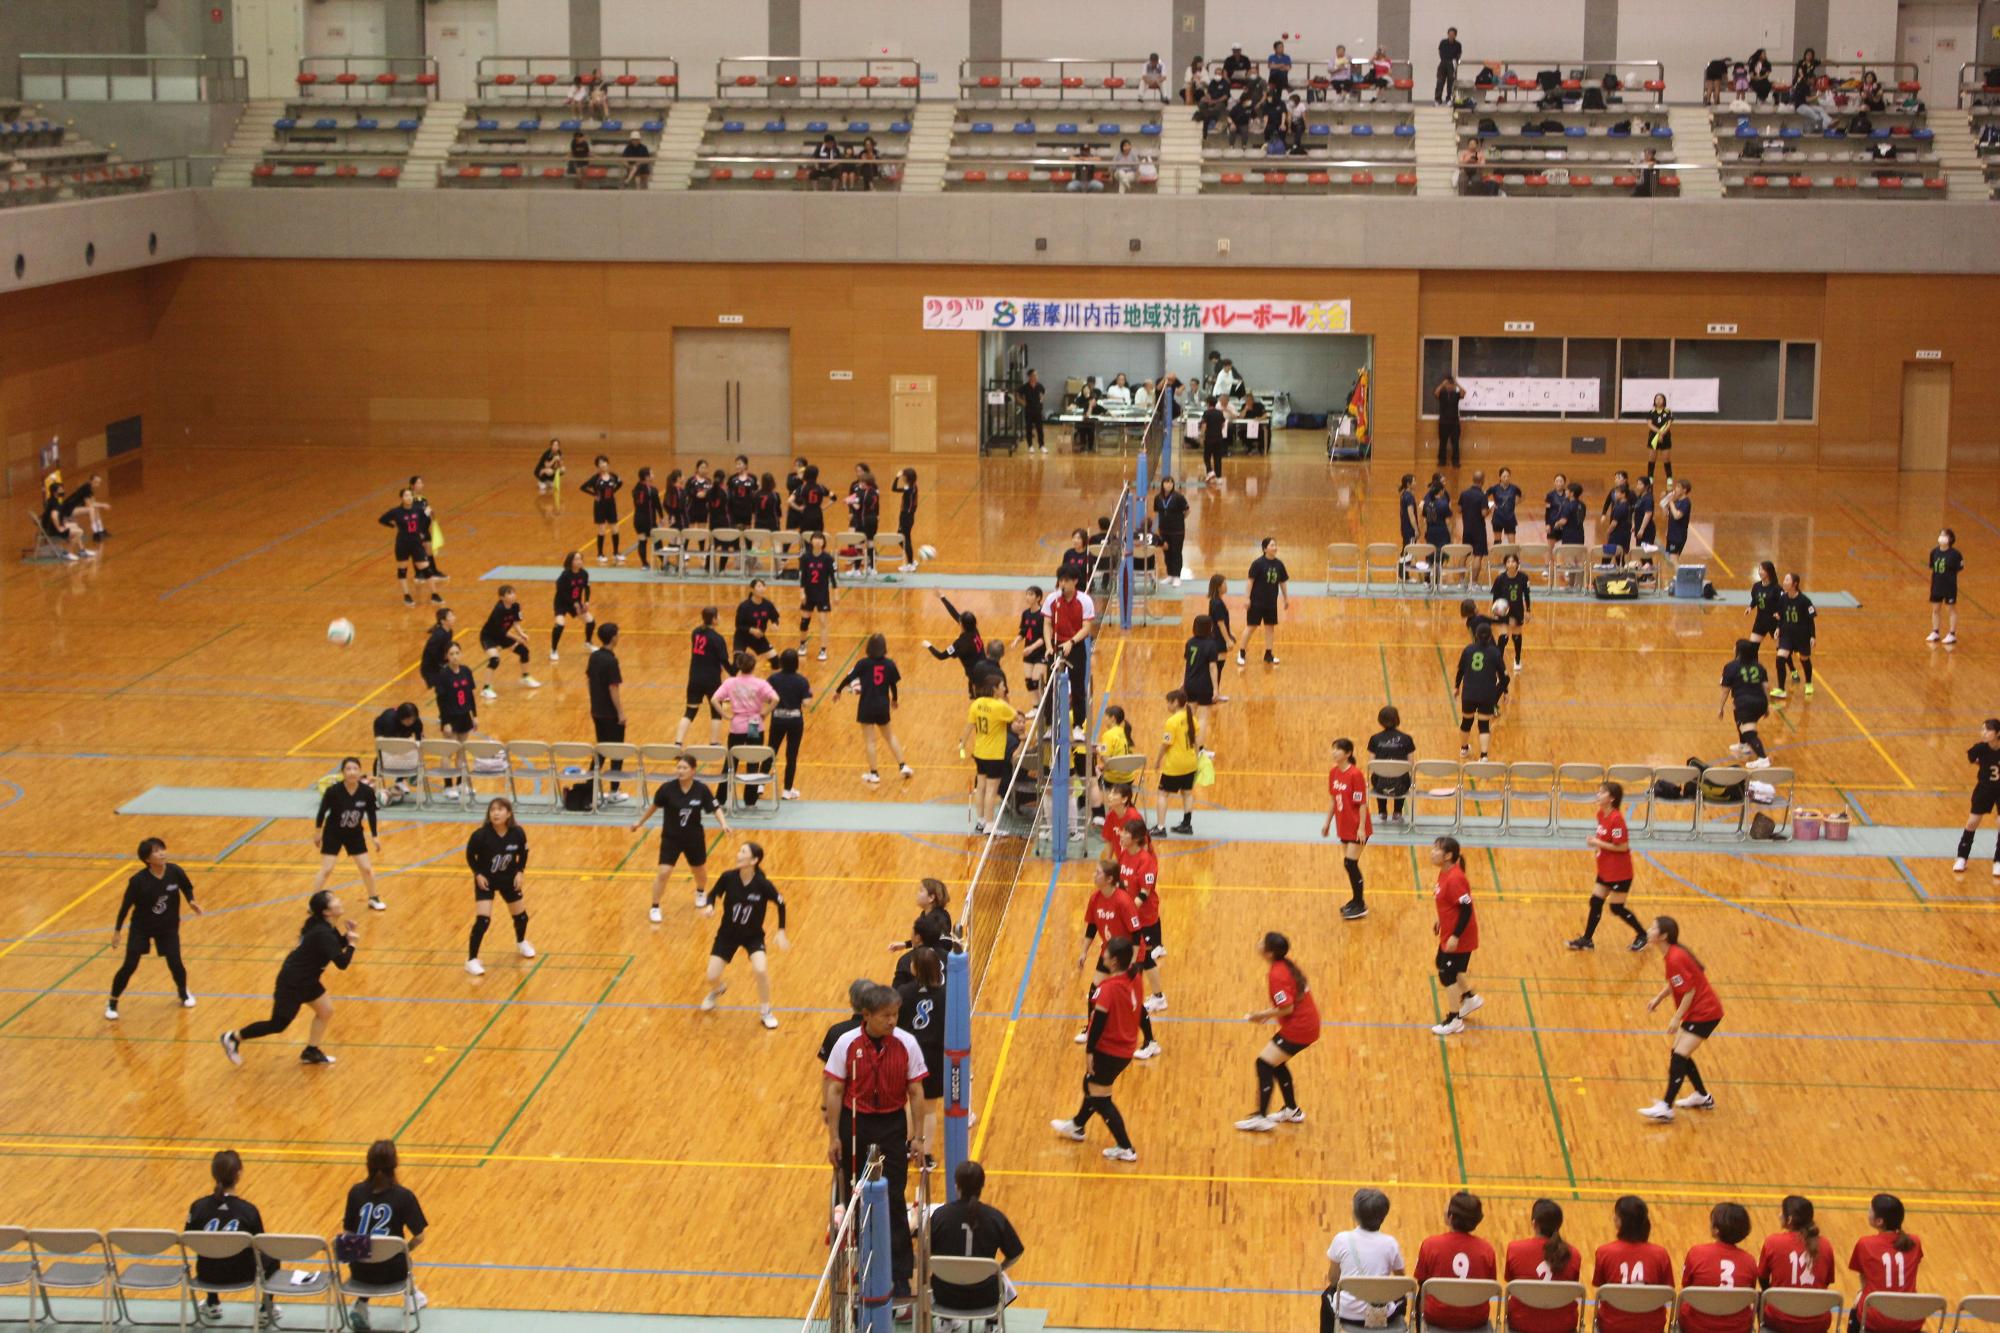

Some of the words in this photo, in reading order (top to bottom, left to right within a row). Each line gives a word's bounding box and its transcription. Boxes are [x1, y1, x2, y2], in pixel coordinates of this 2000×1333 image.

[1022, 302, 1346, 330] 薩摩川内市地域対抗バレーボール大会
[811, 569, 819, 583] 2
[693, 634, 707, 655] 12
[1190, 646, 1198, 666] 7
[1471, 651, 1485, 671] 8
[874, 665, 885, 686] 5
[679, 808, 692, 827] 7
[152, 895, 168, 915] 5
[732, 903, 753, 925] 11
[1097, 908, 1115, 920] Togo
[912, 999, 934, 1030] 8
[359, 1202, 393, 1236] 12
[1452, 1252, 1470, 1280] 9
[1720, 1260, 1736, 1288] 3
[1881, 1252, 1906, 1287] 11
